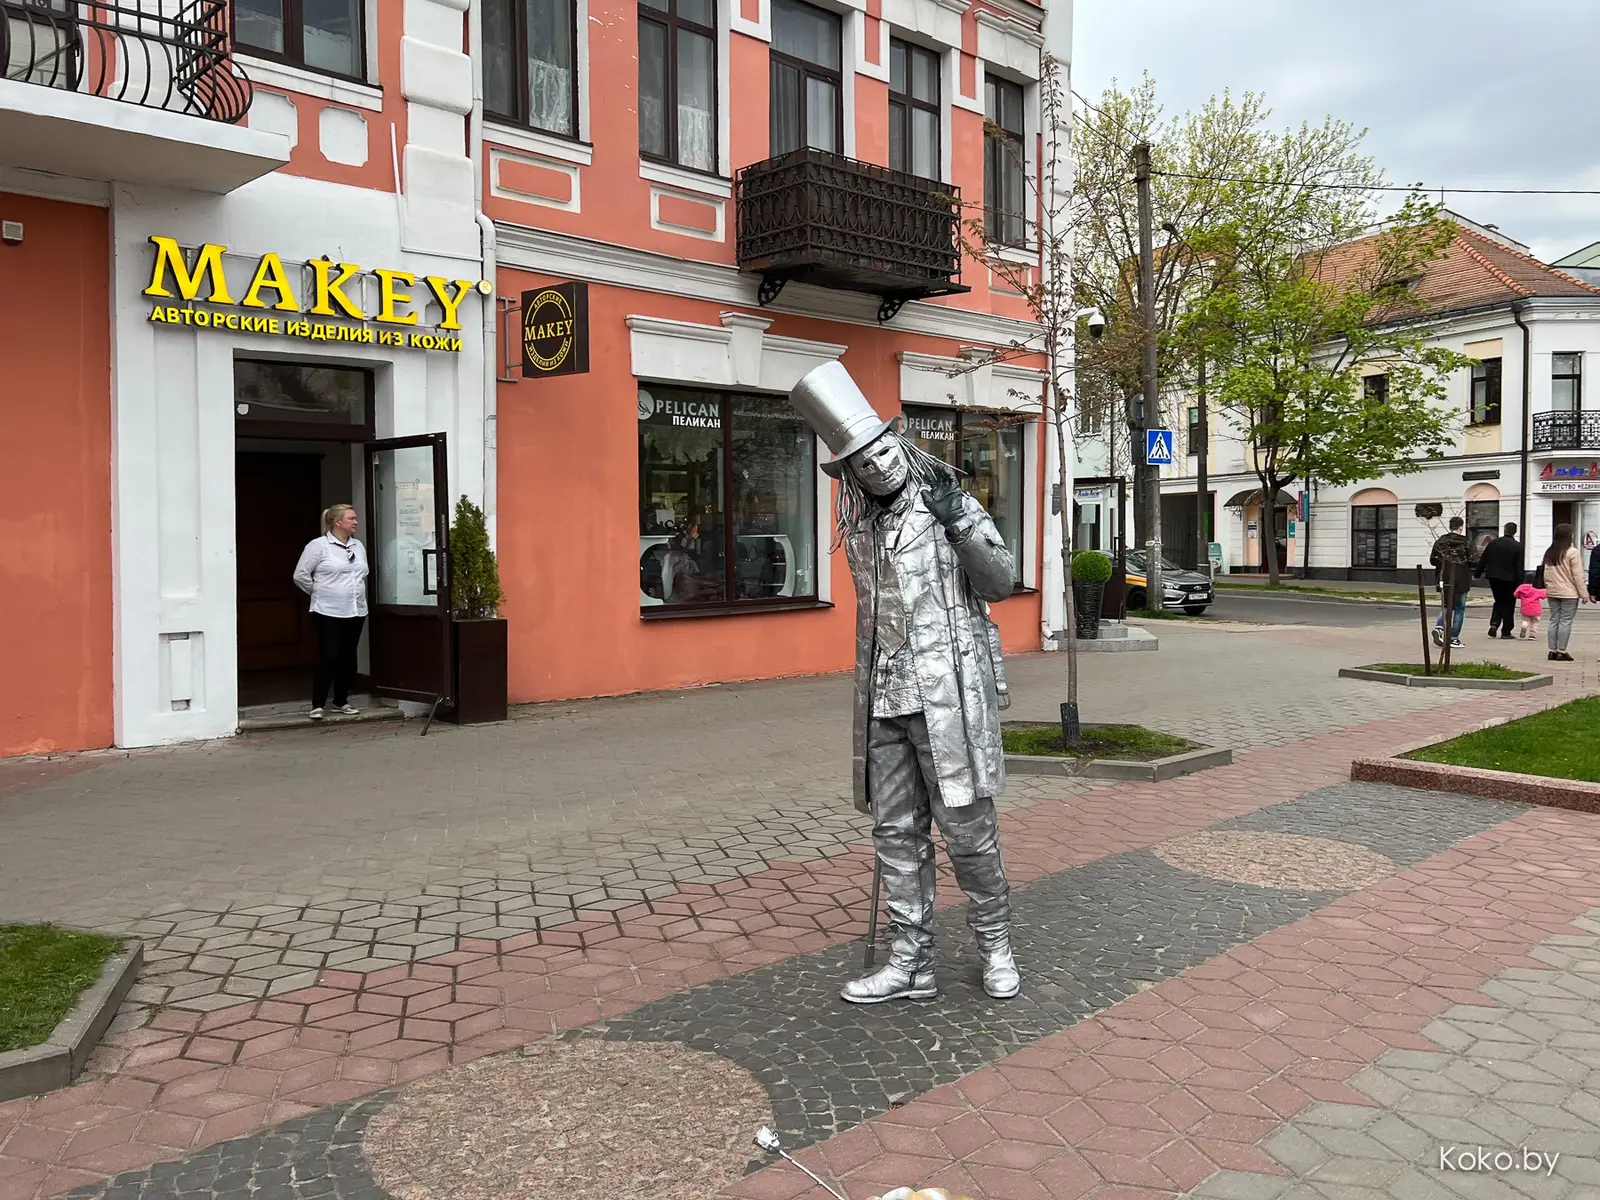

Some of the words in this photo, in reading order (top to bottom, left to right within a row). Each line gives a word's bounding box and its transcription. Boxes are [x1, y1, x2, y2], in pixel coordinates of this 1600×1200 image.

[142, 235, 472, 331] MAKEY
[150, 305, 279, 335] АВТОРСКИЕ
[286, 320, 373, 344] ИЗДЕЛИЯ
[378, 331, 404, 347] ИЗ
[410, 333, 462, 351] КОЖИ
[524, 319, 573, 342] MAKEY
[655, 400, 719, 418] PELICAN
[672, 415, 721, 429] ПЕЛИКАН
[908, 417, 952, 432] PELICAN
[920, 430, 954, 441] ПЕЛИКАН
